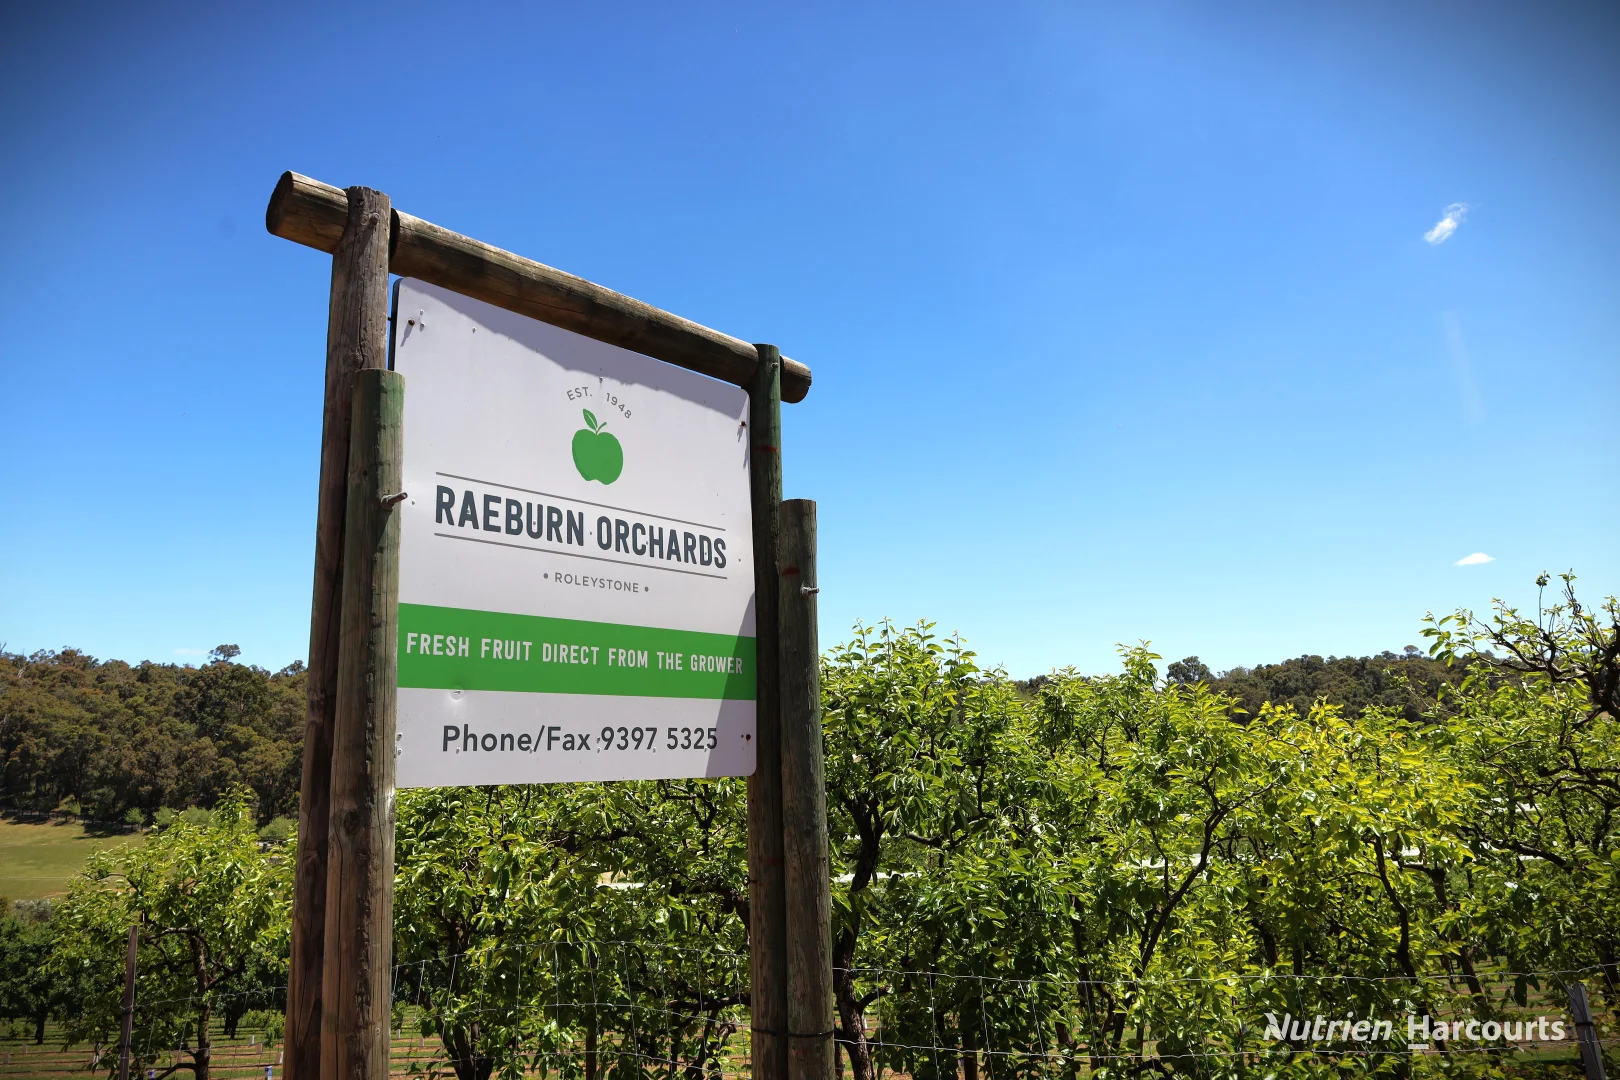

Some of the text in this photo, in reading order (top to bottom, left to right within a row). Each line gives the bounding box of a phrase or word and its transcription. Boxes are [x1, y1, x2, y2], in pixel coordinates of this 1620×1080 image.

[566, 386, 632, 419] EST. 1948
[435, 484, 727, 569] RAEBURN ORCHARDS
[554, 572, 640, 593] ROLEYSTONE
[406, 632, 743, 675] FRESH FRUIT DIRECT FROM THE GROWER
[442, 723, 718, 753] Phone/Fax 9397 5325
